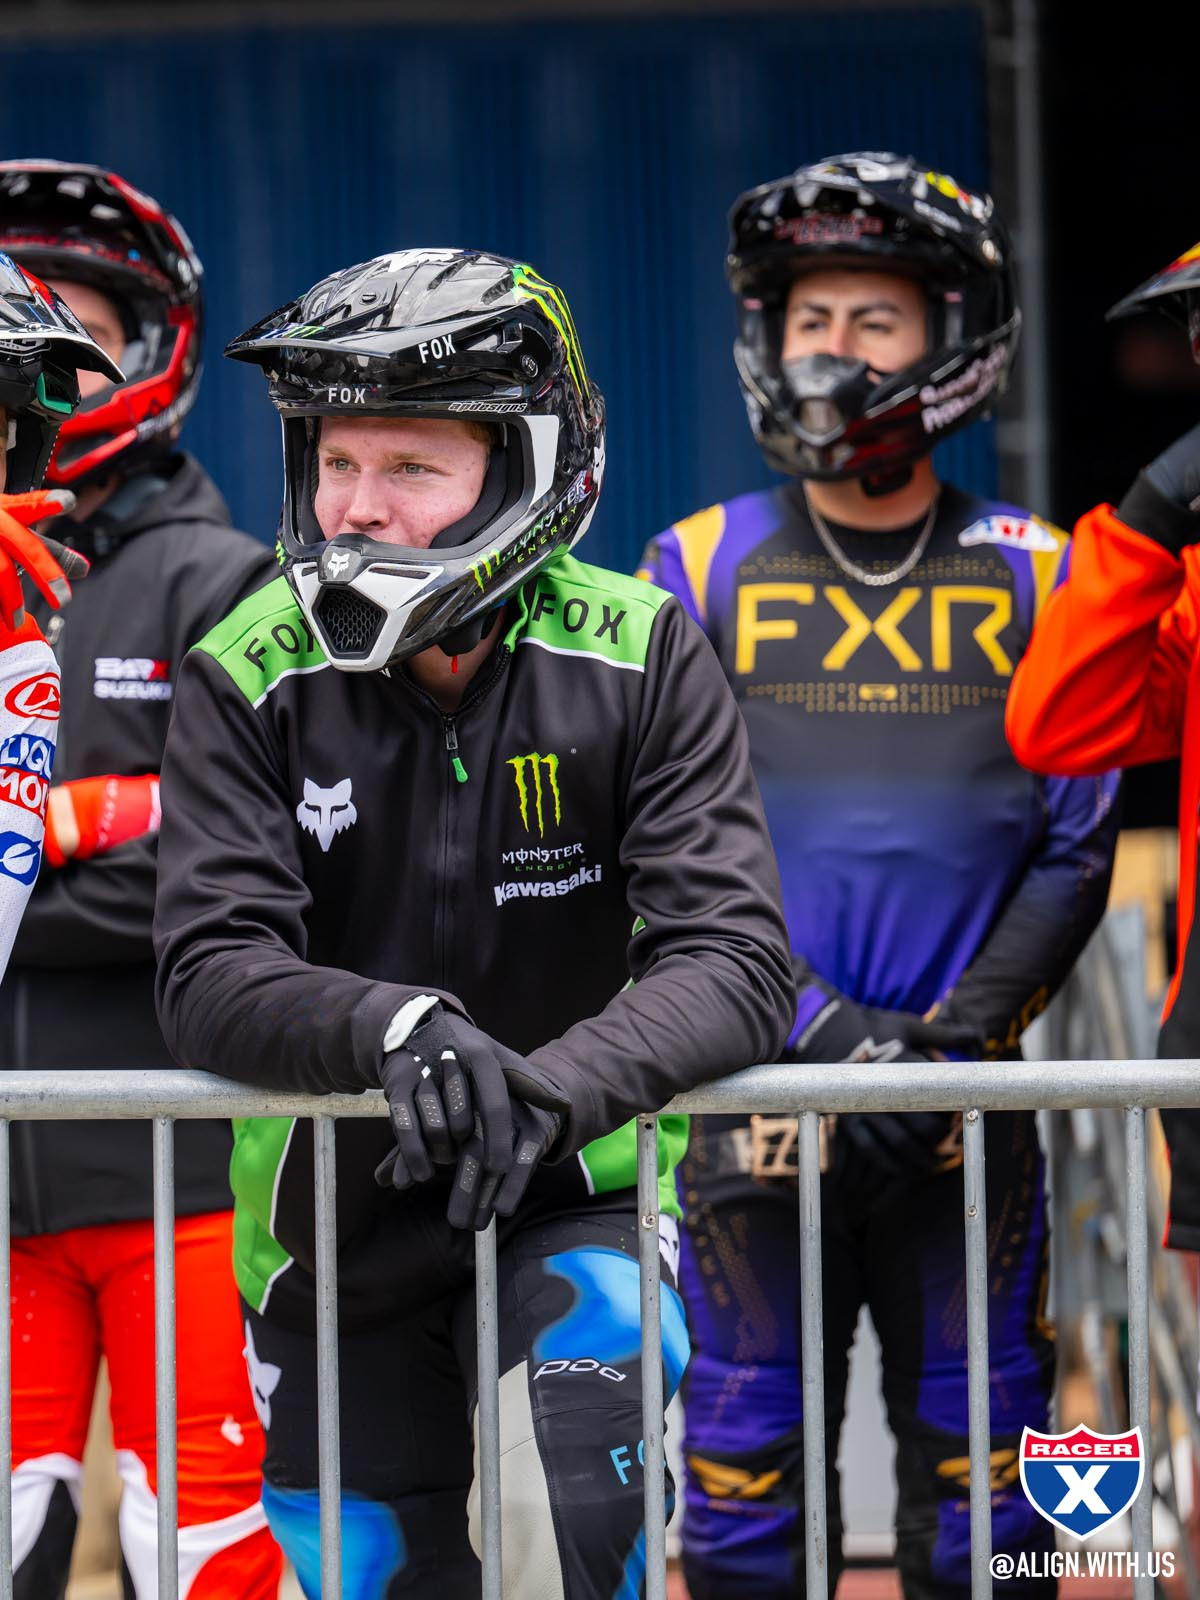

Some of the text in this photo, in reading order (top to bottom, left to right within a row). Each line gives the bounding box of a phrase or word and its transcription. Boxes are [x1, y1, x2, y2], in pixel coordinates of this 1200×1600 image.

[418, 333, 457, 364] FOX
[328, 386, 366, 404] FOX
[449, 401, 528, 413] apdesigns
[516, 505, 577, 563] ENERGY
[532, 591, 628, 644] FOX
[735, 582, 1013, 676] FXR
[93, 679, 172, 700] SUZUKI
[2, 736, 52, 783] LIQ
[502, 842, 585, 865] MONSTER
[515, 860, 573, 872] ENERGY
[493, 864, 603, 907] Kawasaki
